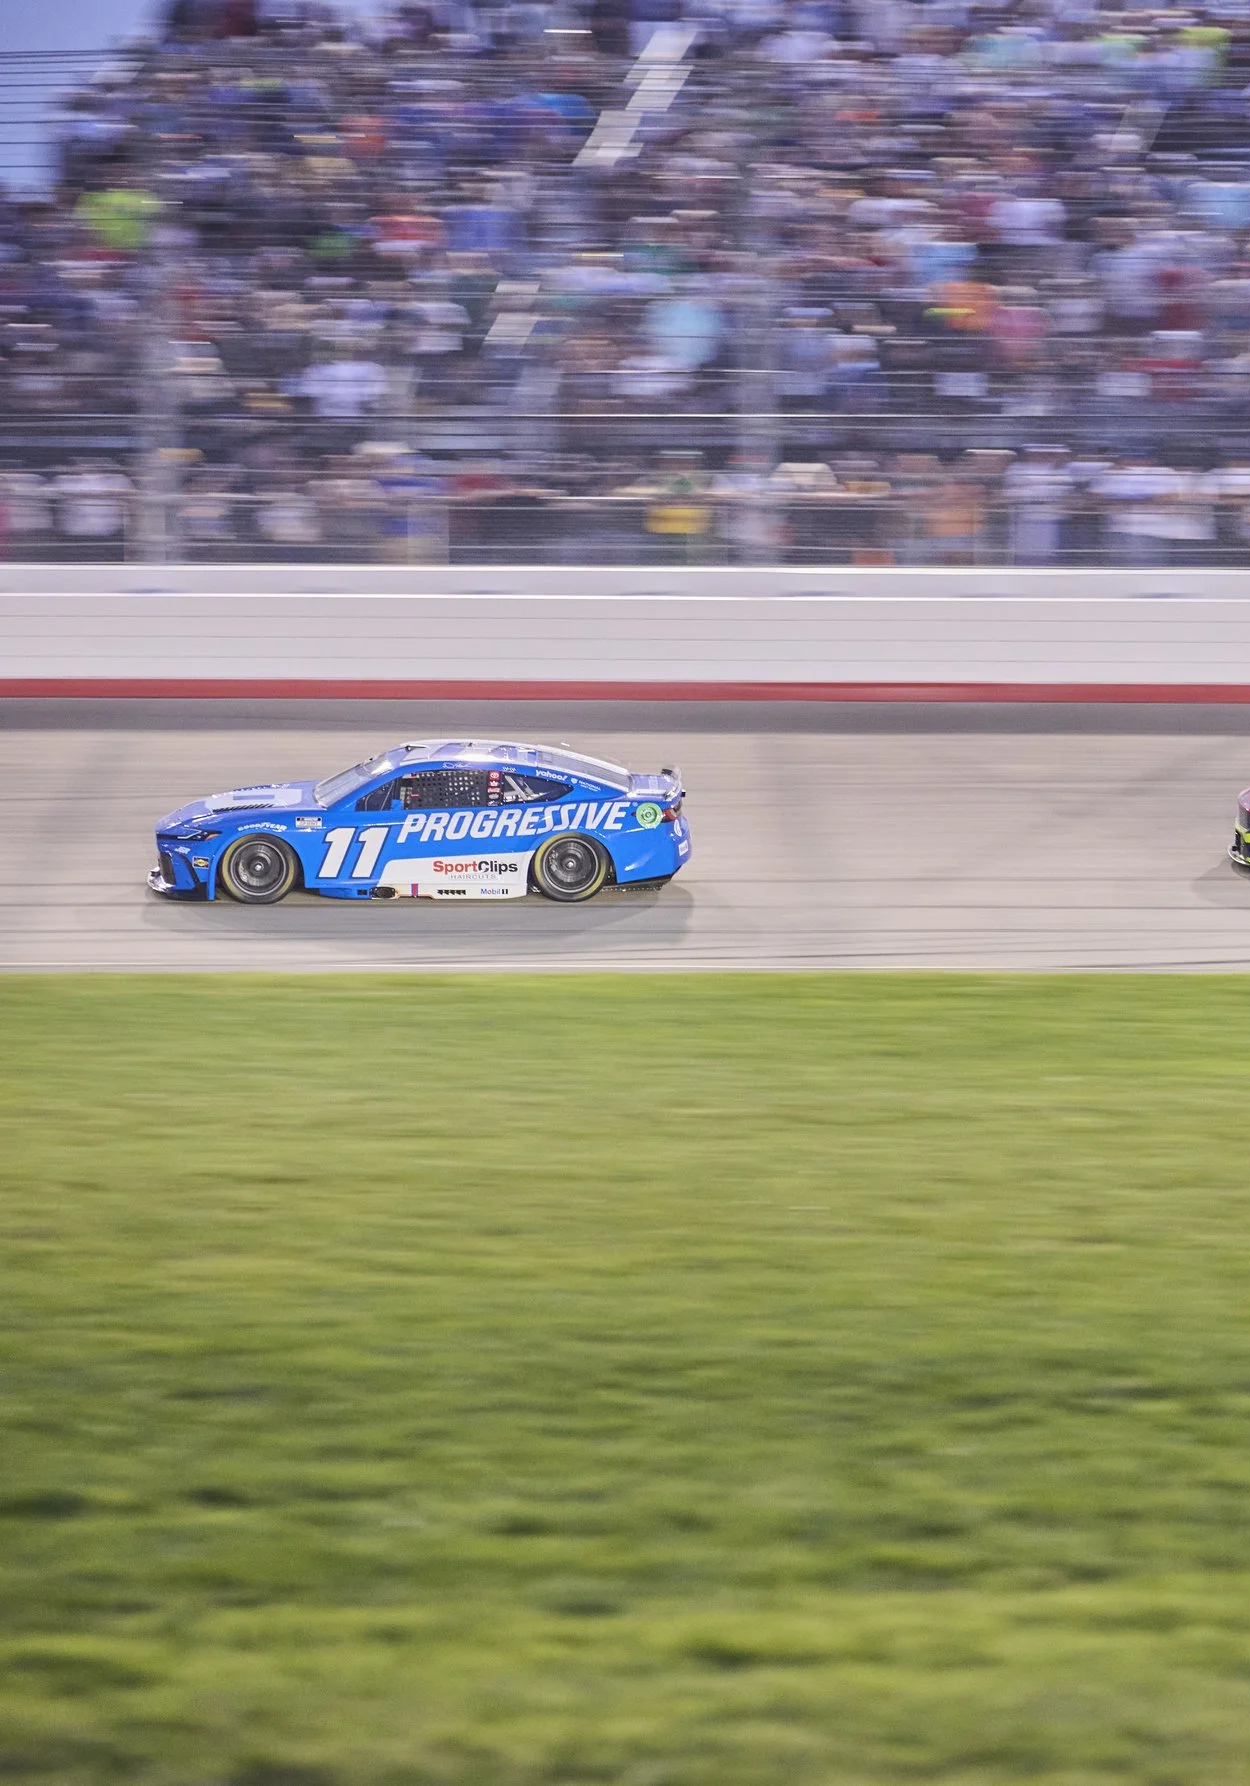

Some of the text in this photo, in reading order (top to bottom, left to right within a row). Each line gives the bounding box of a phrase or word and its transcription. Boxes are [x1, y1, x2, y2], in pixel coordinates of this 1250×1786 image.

[535, 769, 568, 782] yahoo!
[396, 802, 631, 844] PROGRESSIVE
[318, 827, 390, 879] 11
[433, 860, 518, 875] SportClips
